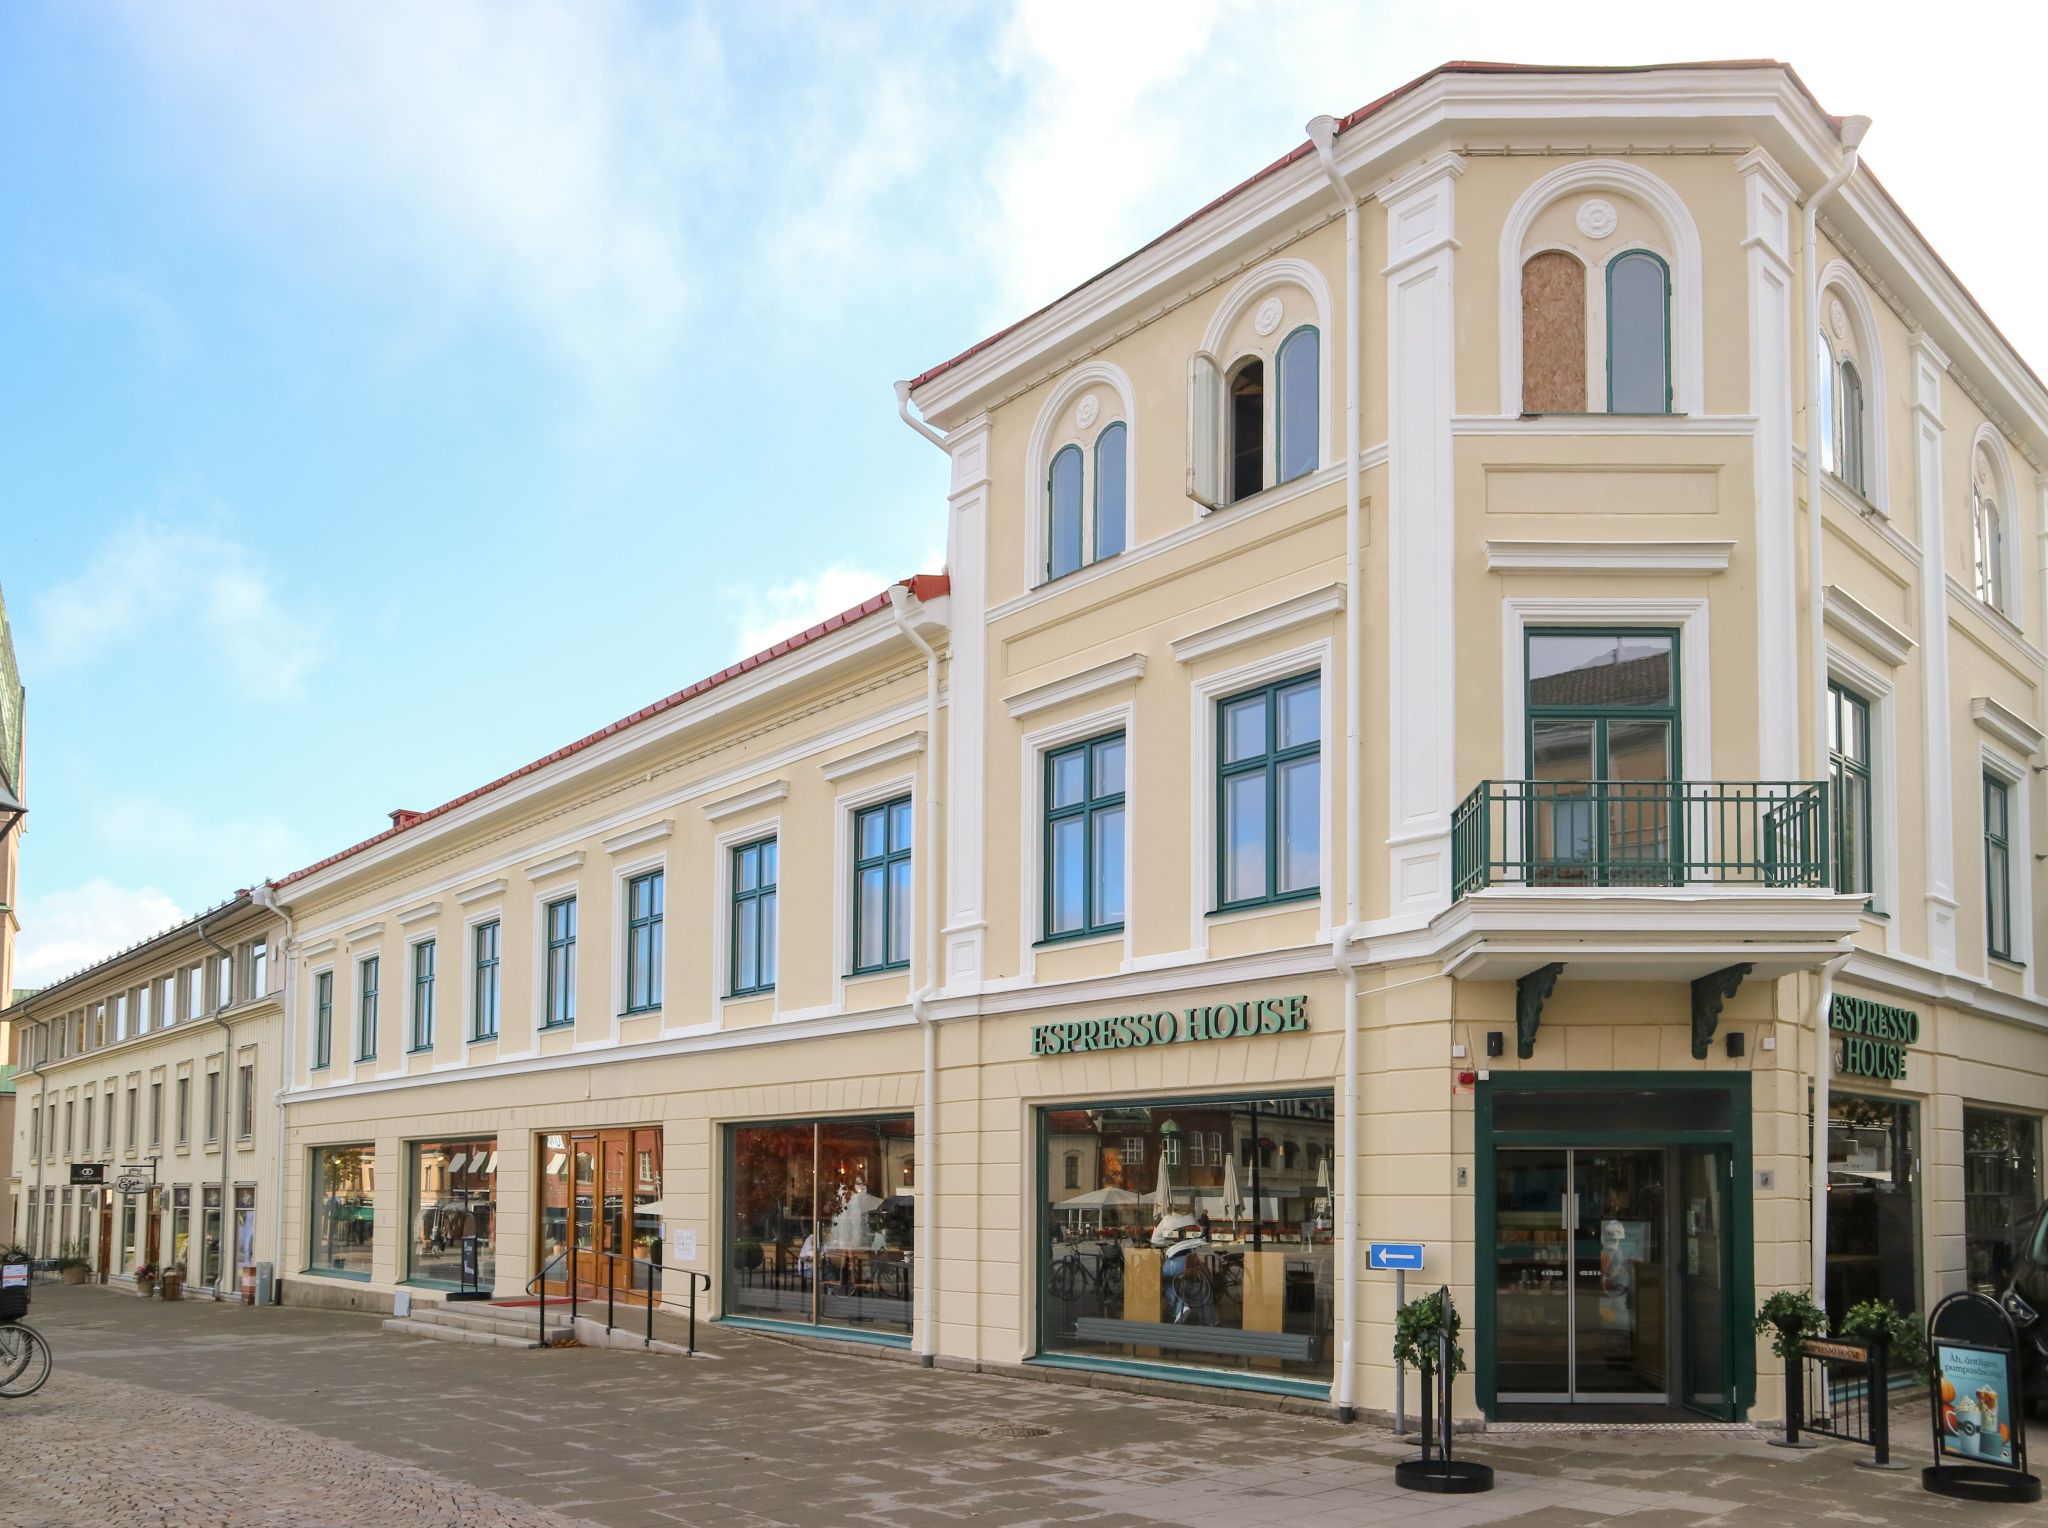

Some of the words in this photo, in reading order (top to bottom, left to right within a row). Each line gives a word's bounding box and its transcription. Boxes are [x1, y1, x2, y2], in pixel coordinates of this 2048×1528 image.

[1031, 1011, 1177, 1056] ESPRESSO
[1183, 995, 1308, 1041] HOUSE
[1831, 992, 1920, 1044] ESPRESSO
[1846, 1037, 1907, 1080] HOUSE
[1964, 1356, 1998, 1369] äntligen
